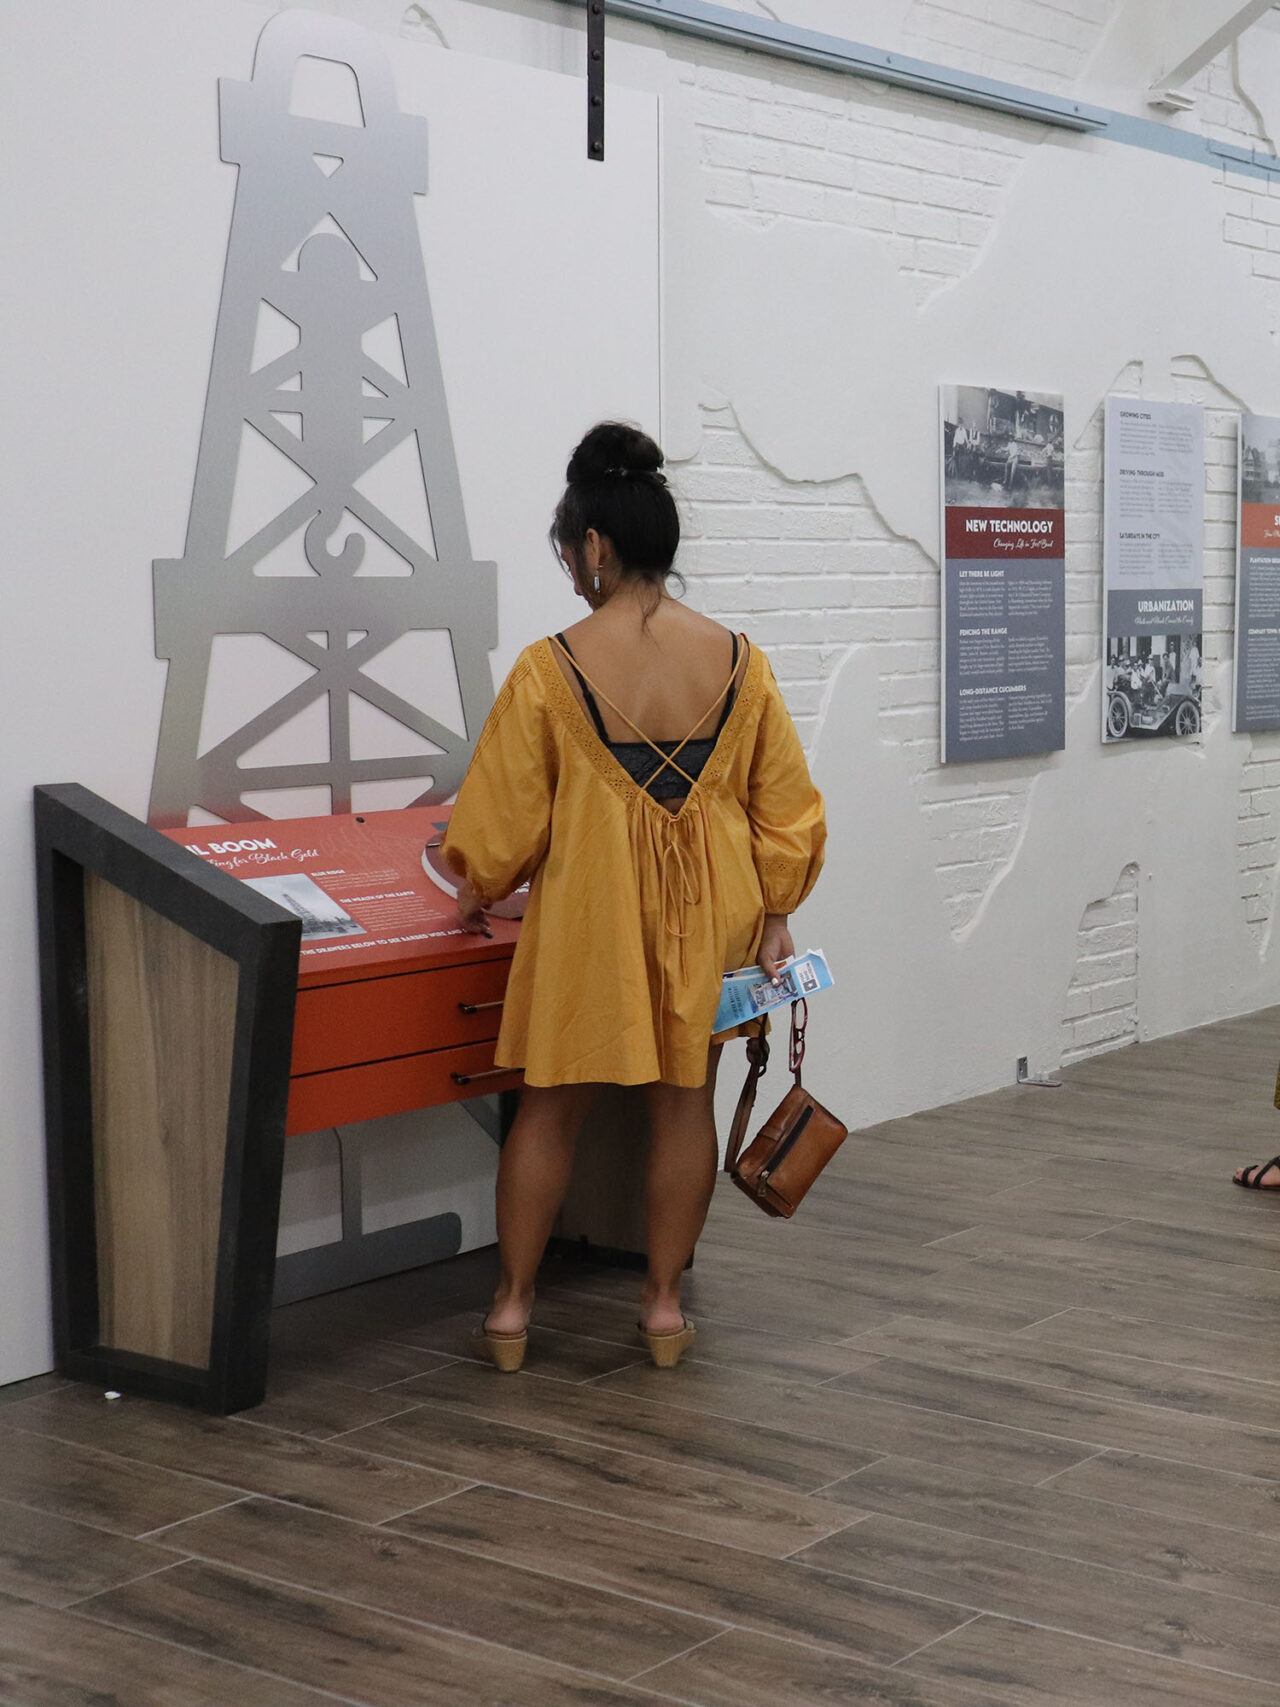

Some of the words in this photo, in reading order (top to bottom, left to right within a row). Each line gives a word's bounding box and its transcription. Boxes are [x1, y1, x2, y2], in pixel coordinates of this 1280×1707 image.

[965, 519, 988, 532] NEW
[989, 520, 1054, 533] TECHNOLOGY
[959, 570, 968, 578] LET
[1137, 600, 1194, 612] URBANIZATION
[184, 844, 210, 856] IL
[208, 838, 278, 854] BOOM
[248, 852, 289, 865] Black
[290, 848, 320, 862] Gold
[351, 940, 376, 949] BELOW
[388, 936, 401, 944] SEE
[447, 928, 462, 936] AND
